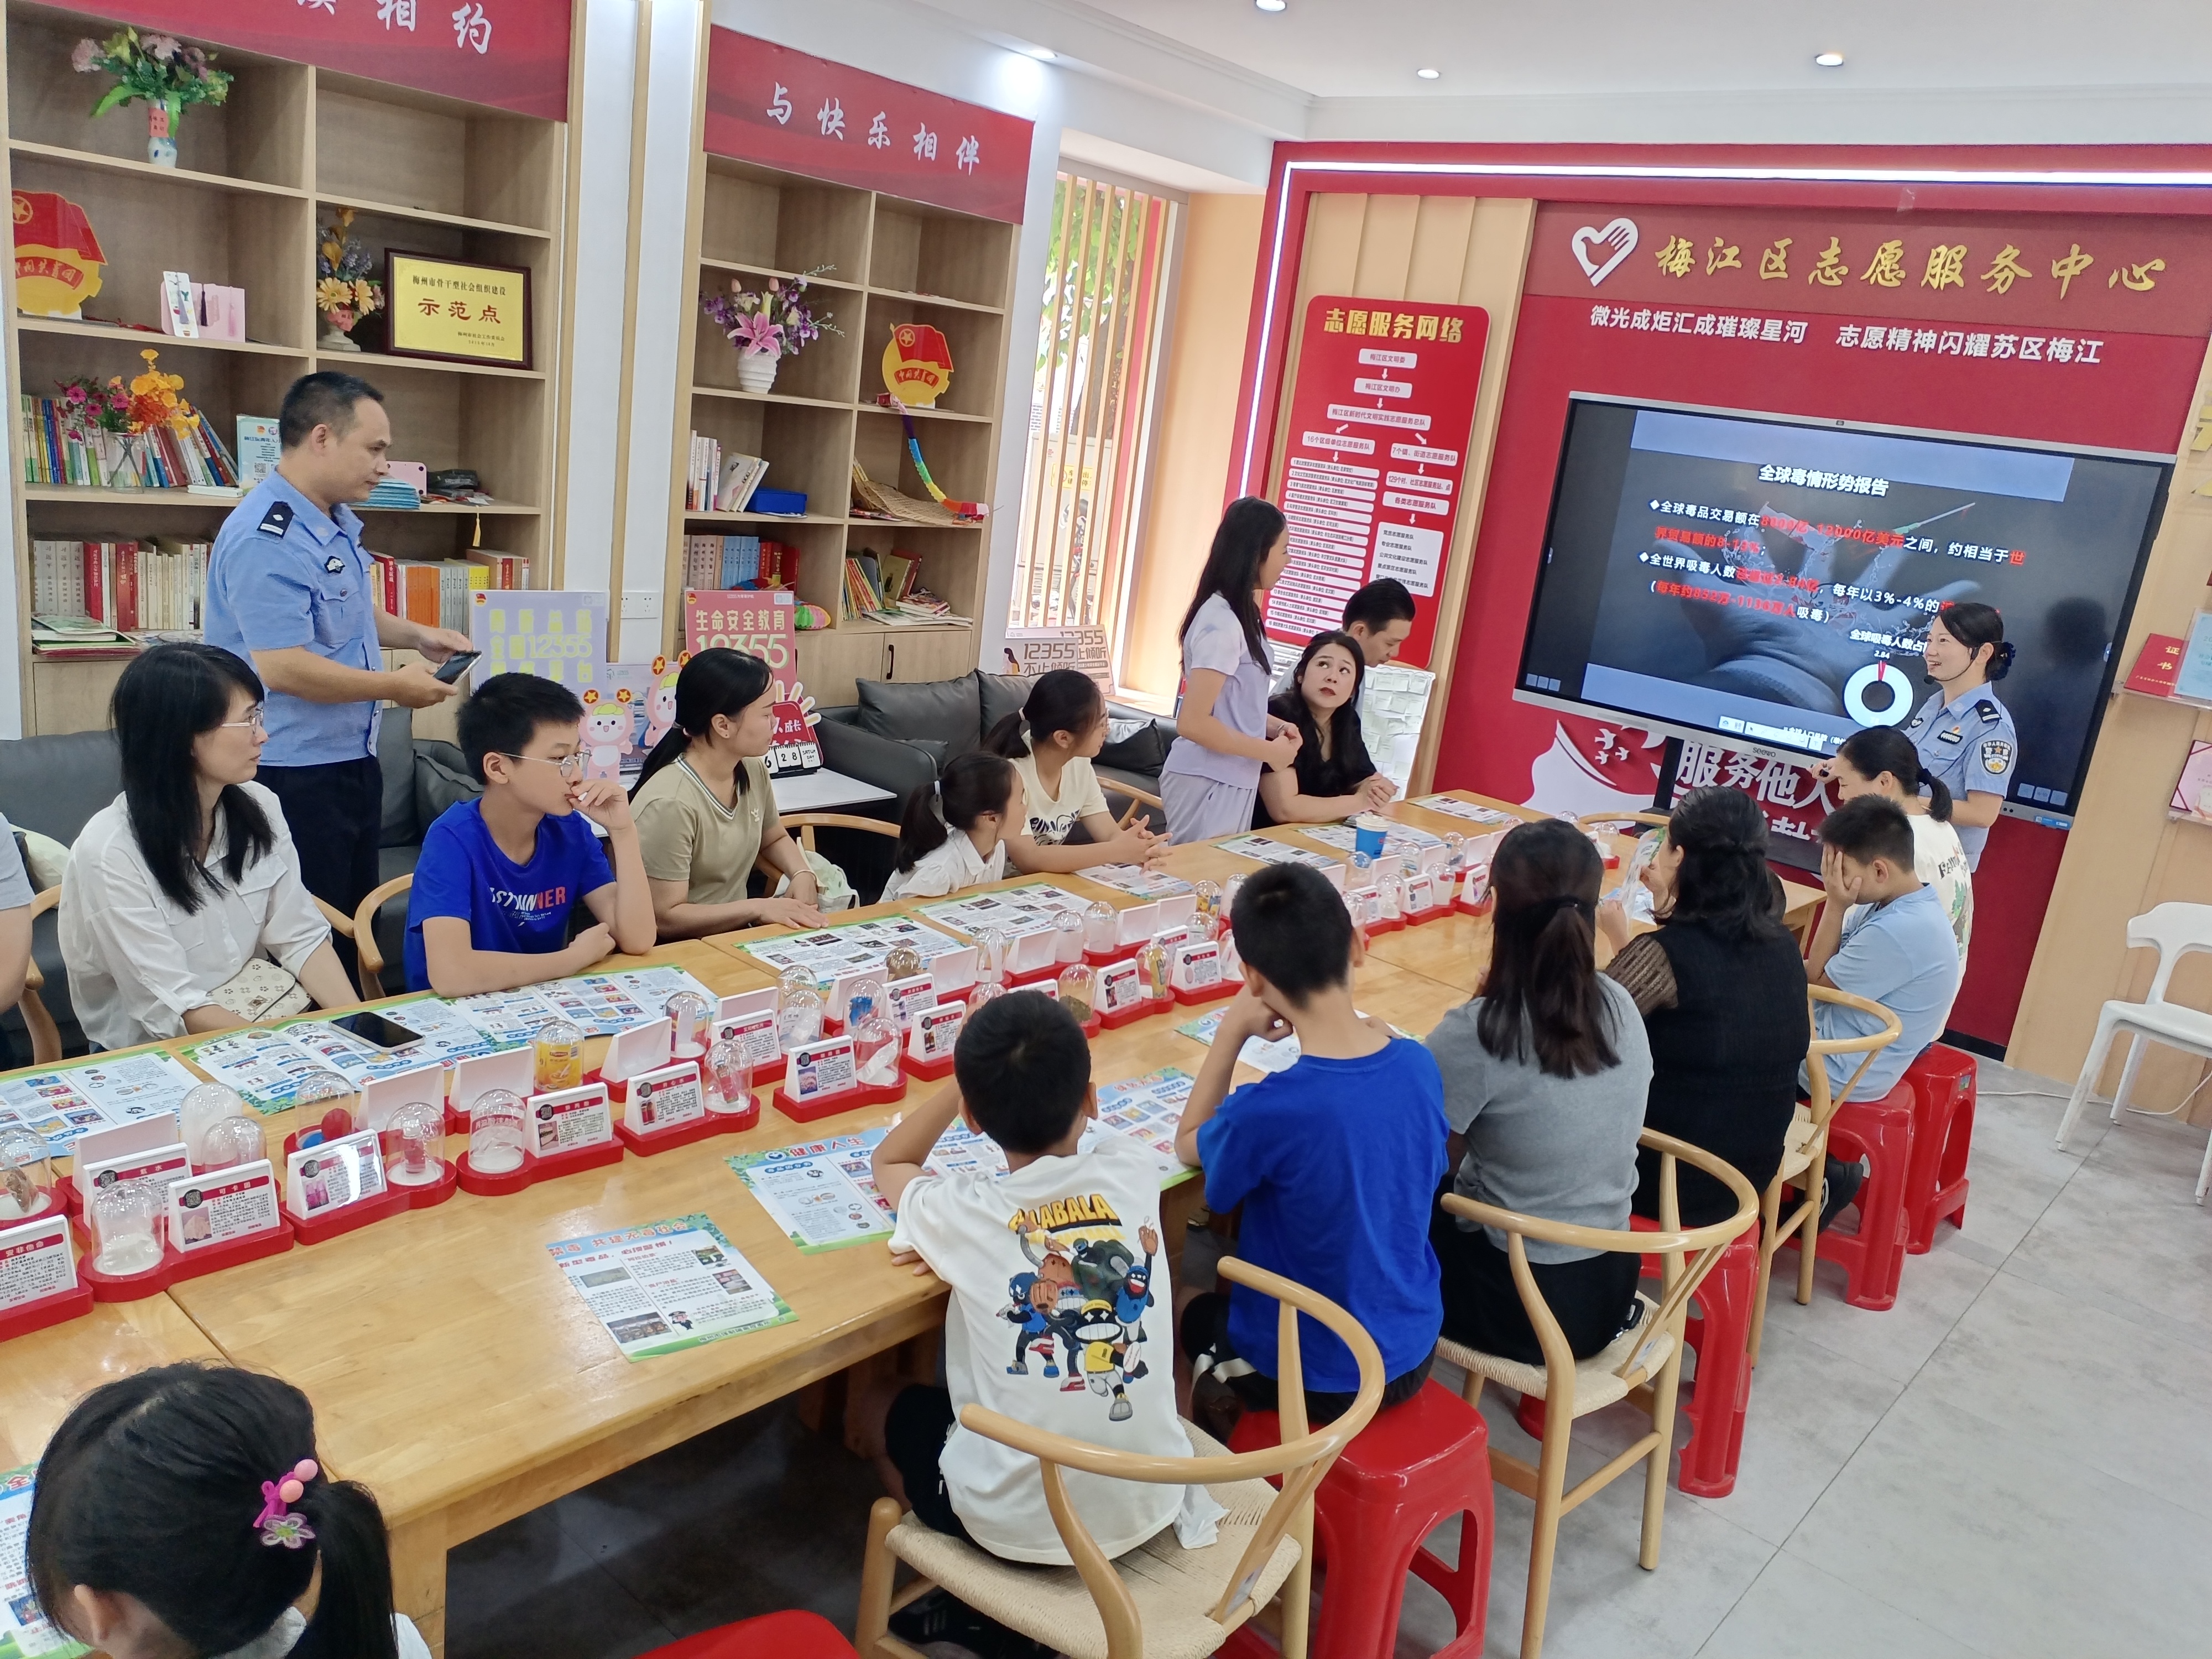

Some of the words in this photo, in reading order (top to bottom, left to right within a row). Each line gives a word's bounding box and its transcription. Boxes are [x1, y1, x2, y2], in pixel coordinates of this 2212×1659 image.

[297, 0, 492, 54] 相约
[767, 82, 980, 175] 与快乐相伴
[1655, 234, 2166, 299] 梅江区志愿服务中心
[413, 275, 506, 295] 梅州市骨干型社会组织建设
[418, 298, 500, 324] 示范点
[1324, 307, 1464, 343] 志愿服务网络
[1590, 305, 1807, 345] 微光成炬汇成璀璨星河
[1836, 324, 2104, 364] 志愿精神闪耀苏区梅江
[1370, 353, 1405, 363] 梅江区文明委
[1365, 383, 1400, 393] 梅江区文明办
[1759, 465, 1887, 496] 全球毒情形势报告
[1395, 497, 1436, 509] 各类志愿服务队
[696, 610, 785, 631] 生命安全教育
[1024, 643, 1076, 659] 12355
[1850, 629, 1927, 653] 全球吸毒人数占
[1874, 650, 1890, 659] 2.84
[765, 756, 771, 768] 6
[1753, 747, 1776, 757] seewo
[1674, 740, 1837, 816] 服务他人
[790, 1138, 865, 1157] 健康人生
[592, 1222, 687, 1247] 共建无毒社会
